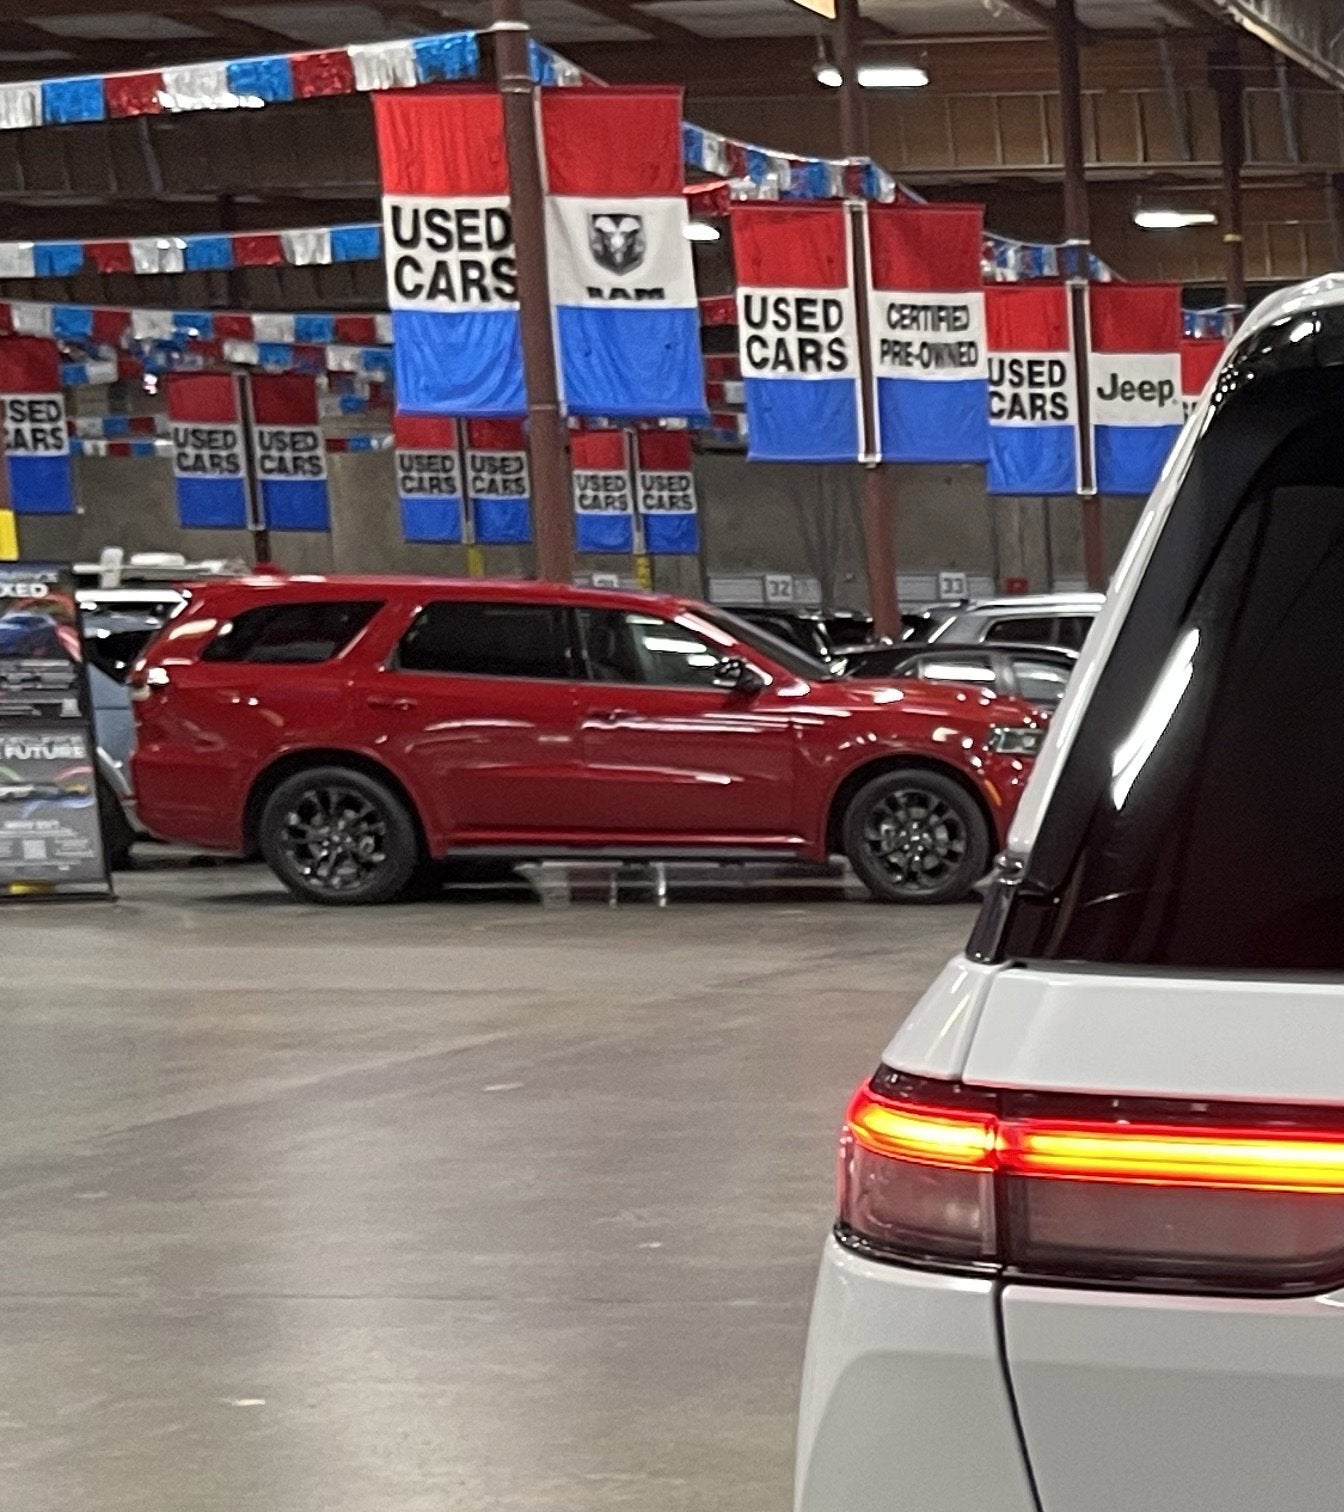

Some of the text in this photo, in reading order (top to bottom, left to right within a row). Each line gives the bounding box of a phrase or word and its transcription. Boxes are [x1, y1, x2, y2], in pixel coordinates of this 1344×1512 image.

[391, 205, 512, 251] USED
[394, 255, 517, 302] CARS
[744, 295, 843, 333] USED
[887, 303, 970, 332] CERTIFIED
[746, 335, 848, 372] CARS
[880, 338, 979, 368] PRE-OWNED
[988, 358, 1067, 388] USED
[1097, 373, 1174, 408] Jeep
[8, 399, 61, 423] SED
[989, 391, 1069, 421] CARS
[5, 428, 64, 451] ARS
[173, 427, 237, 450] USED
[259, 431, 319, 452] USED
[177, 452, 241, 475] CARS
[260, 454, 324, 475] CARS
[400, 454, 456, 474] USED
